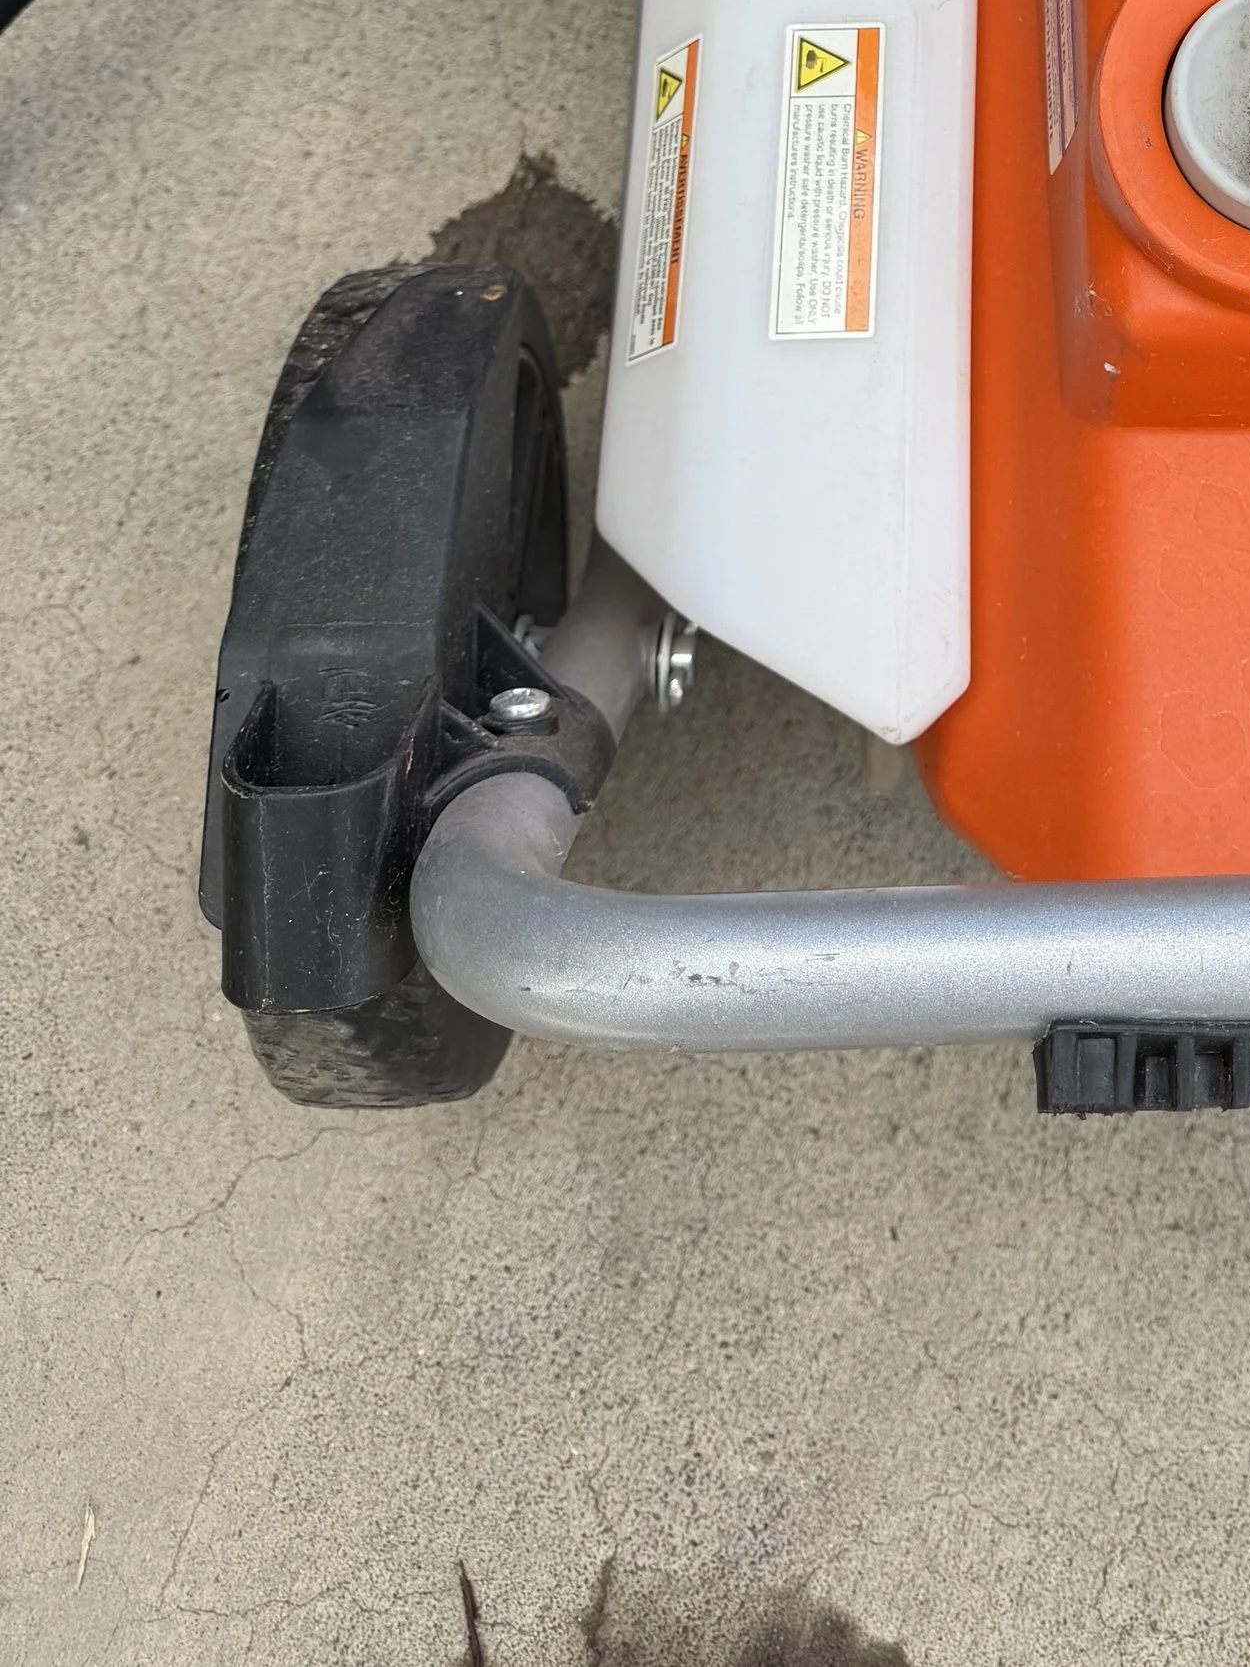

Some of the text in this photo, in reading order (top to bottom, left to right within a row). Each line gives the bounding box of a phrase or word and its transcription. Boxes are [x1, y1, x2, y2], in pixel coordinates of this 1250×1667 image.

[805, 104, 813, 141] pressure
[843, 103, 852, 145] Chemical
[827, 130, 838, 166] resulting
[815, 154, 825, 176] liquid
[815, 180, 823, 197] with
[827, 179, 835, 203] death
[854, 149, 868, 219] WARNING
[812, 199, 821, 238] pressure
[827, 206, 834, 215] or
[836, 260, 844, 284] could
[809, 279, 818, 296] Use
[822, 281, 831, 295] DO
[808, 299, 817, 324] ONLY
[821, 298, 831, 318] NOT
